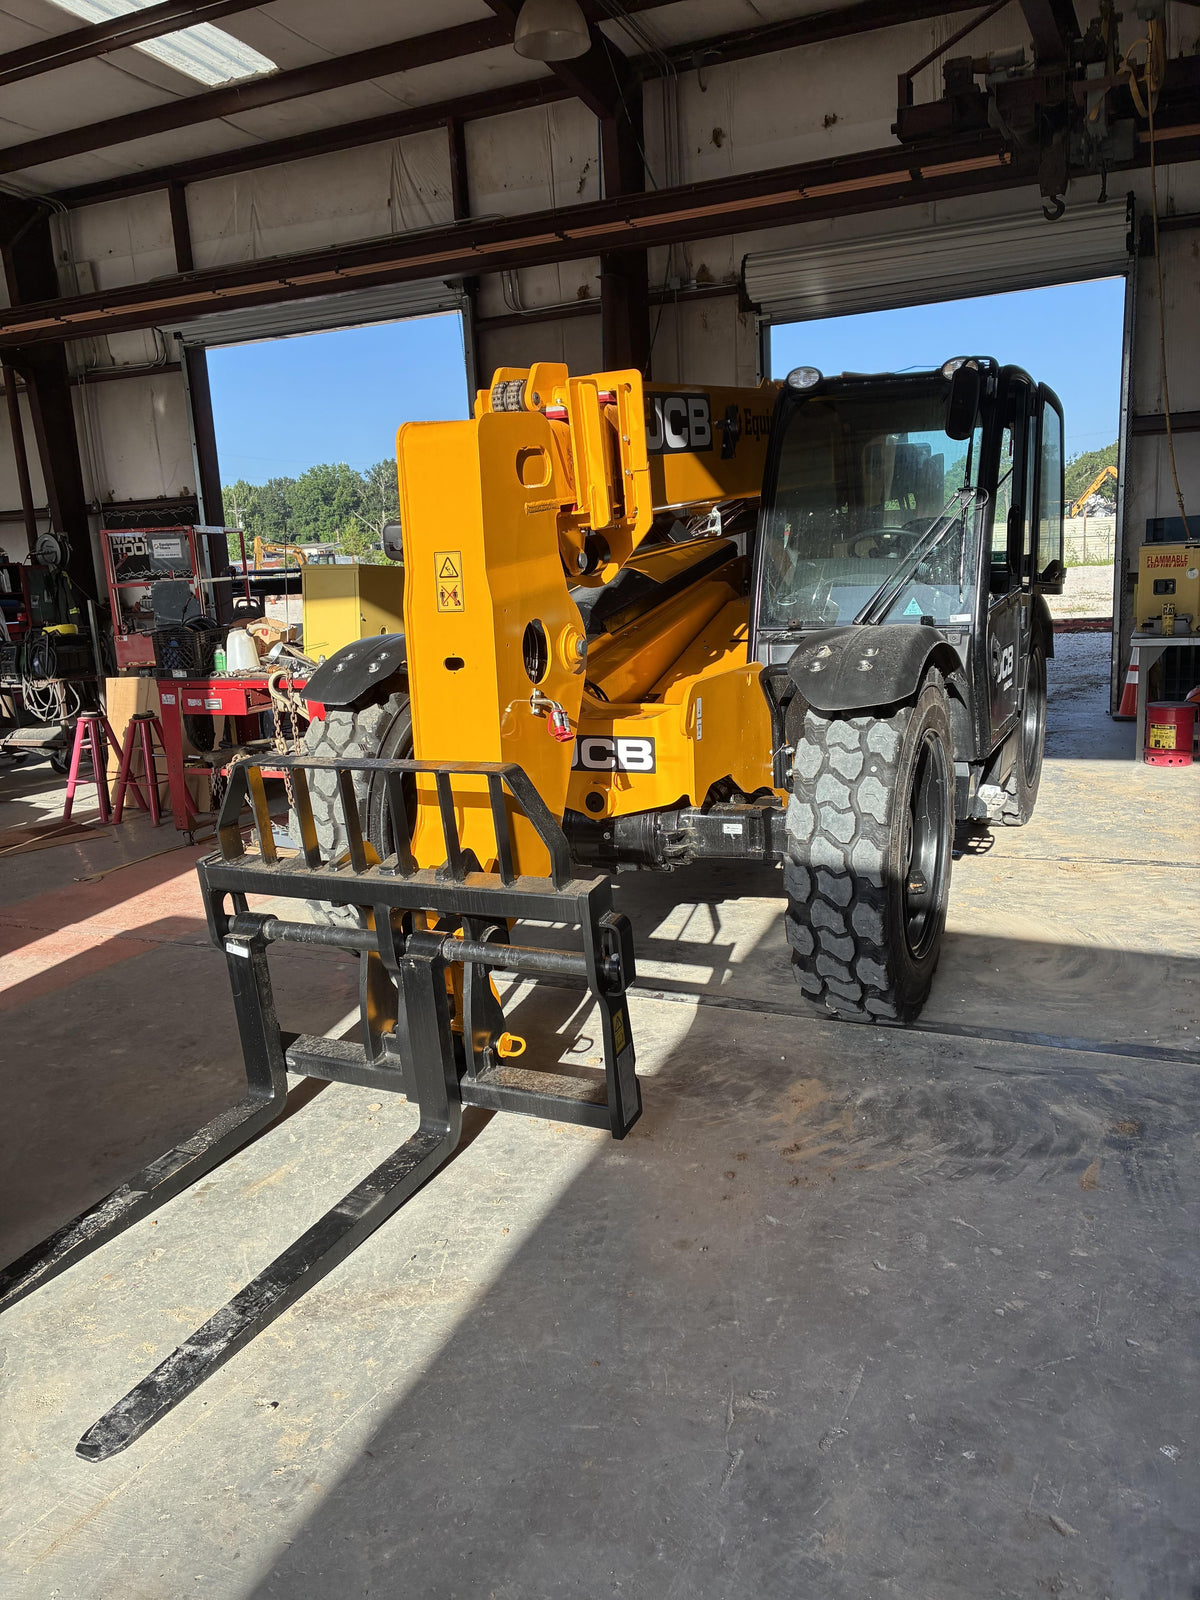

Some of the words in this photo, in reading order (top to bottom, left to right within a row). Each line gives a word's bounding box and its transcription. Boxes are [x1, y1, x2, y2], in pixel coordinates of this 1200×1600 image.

[645, 397, 711, 450] JCB
[743, 407, 774, 442] Equi
[1146, 554, 1189, 564] FLAMMABLE
